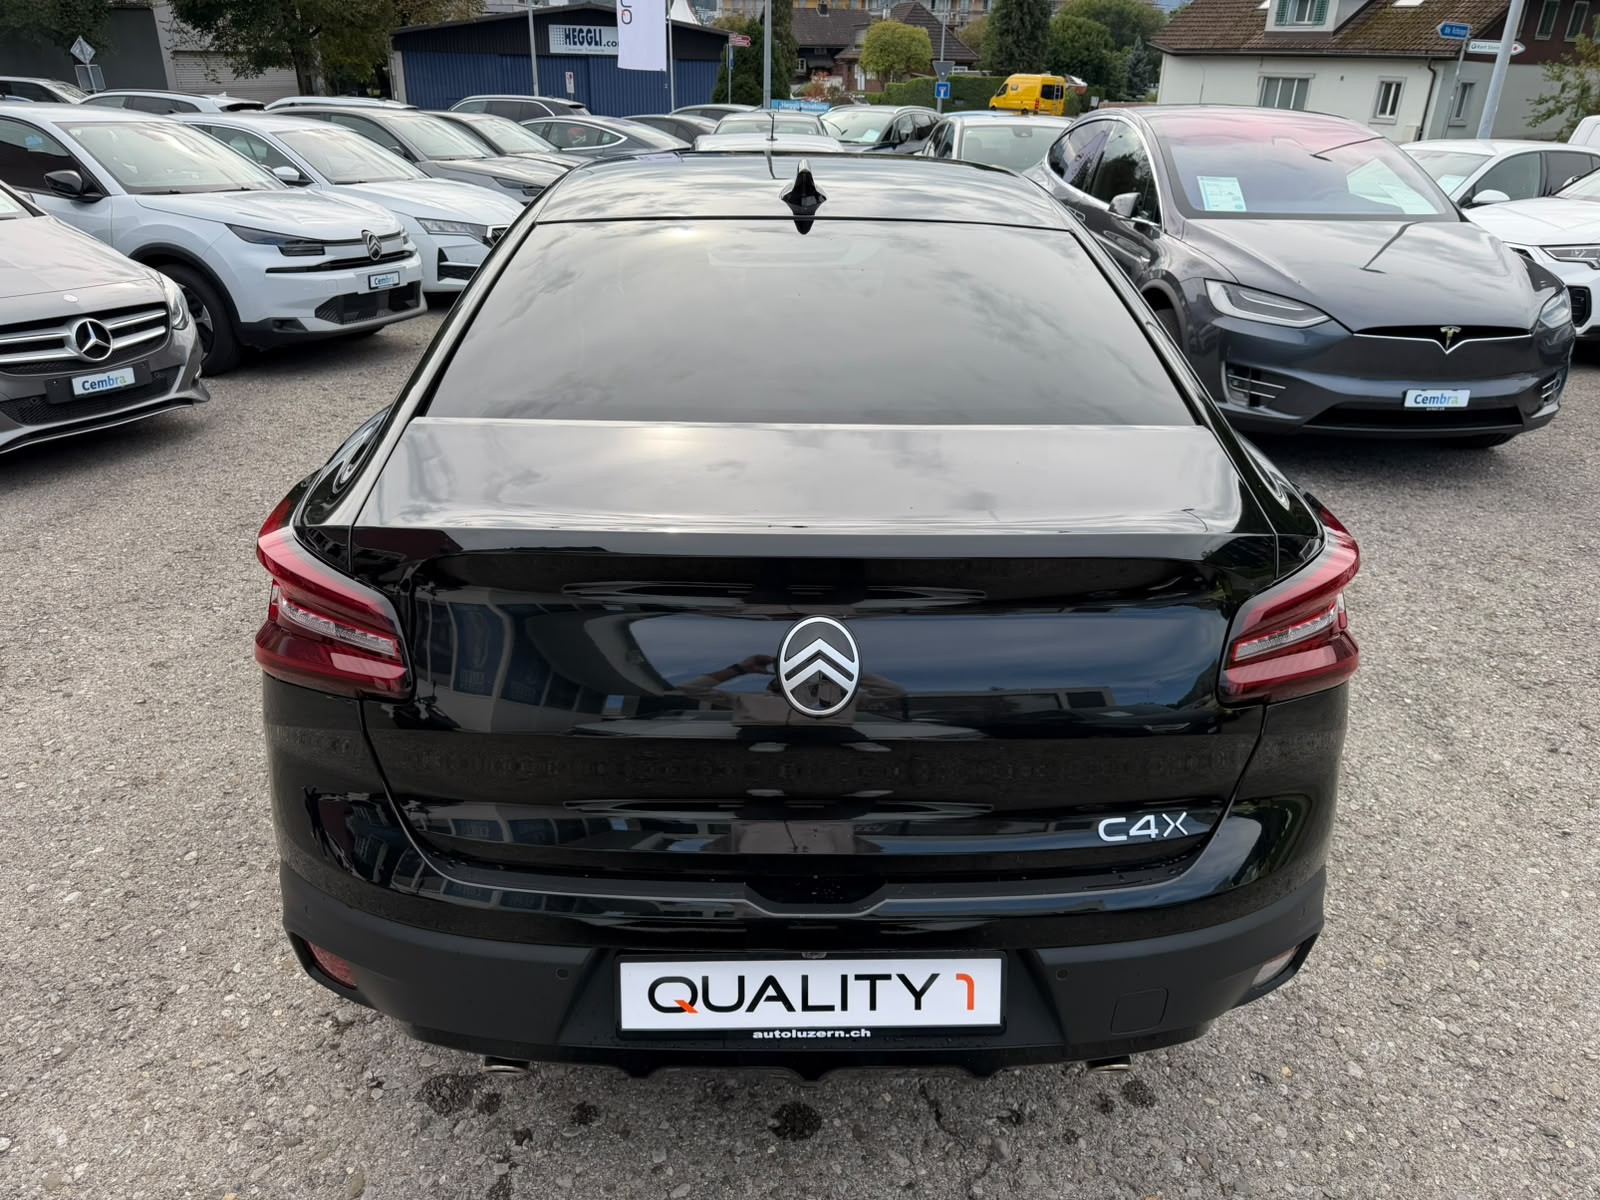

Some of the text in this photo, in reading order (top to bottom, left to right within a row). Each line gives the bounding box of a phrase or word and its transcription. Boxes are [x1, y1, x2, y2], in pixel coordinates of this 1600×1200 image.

[564, 27, 618, 47] HEGGLI.co
[81, 375, 127, 391] Cembra
[1413, 393, 1459, 405] Cembra
[1098, 811, 1189, 842] C4X
[647, 973, 975, 1013] QUALITY 1
[752, 1028, 871, 1040] autoluzern.ch
